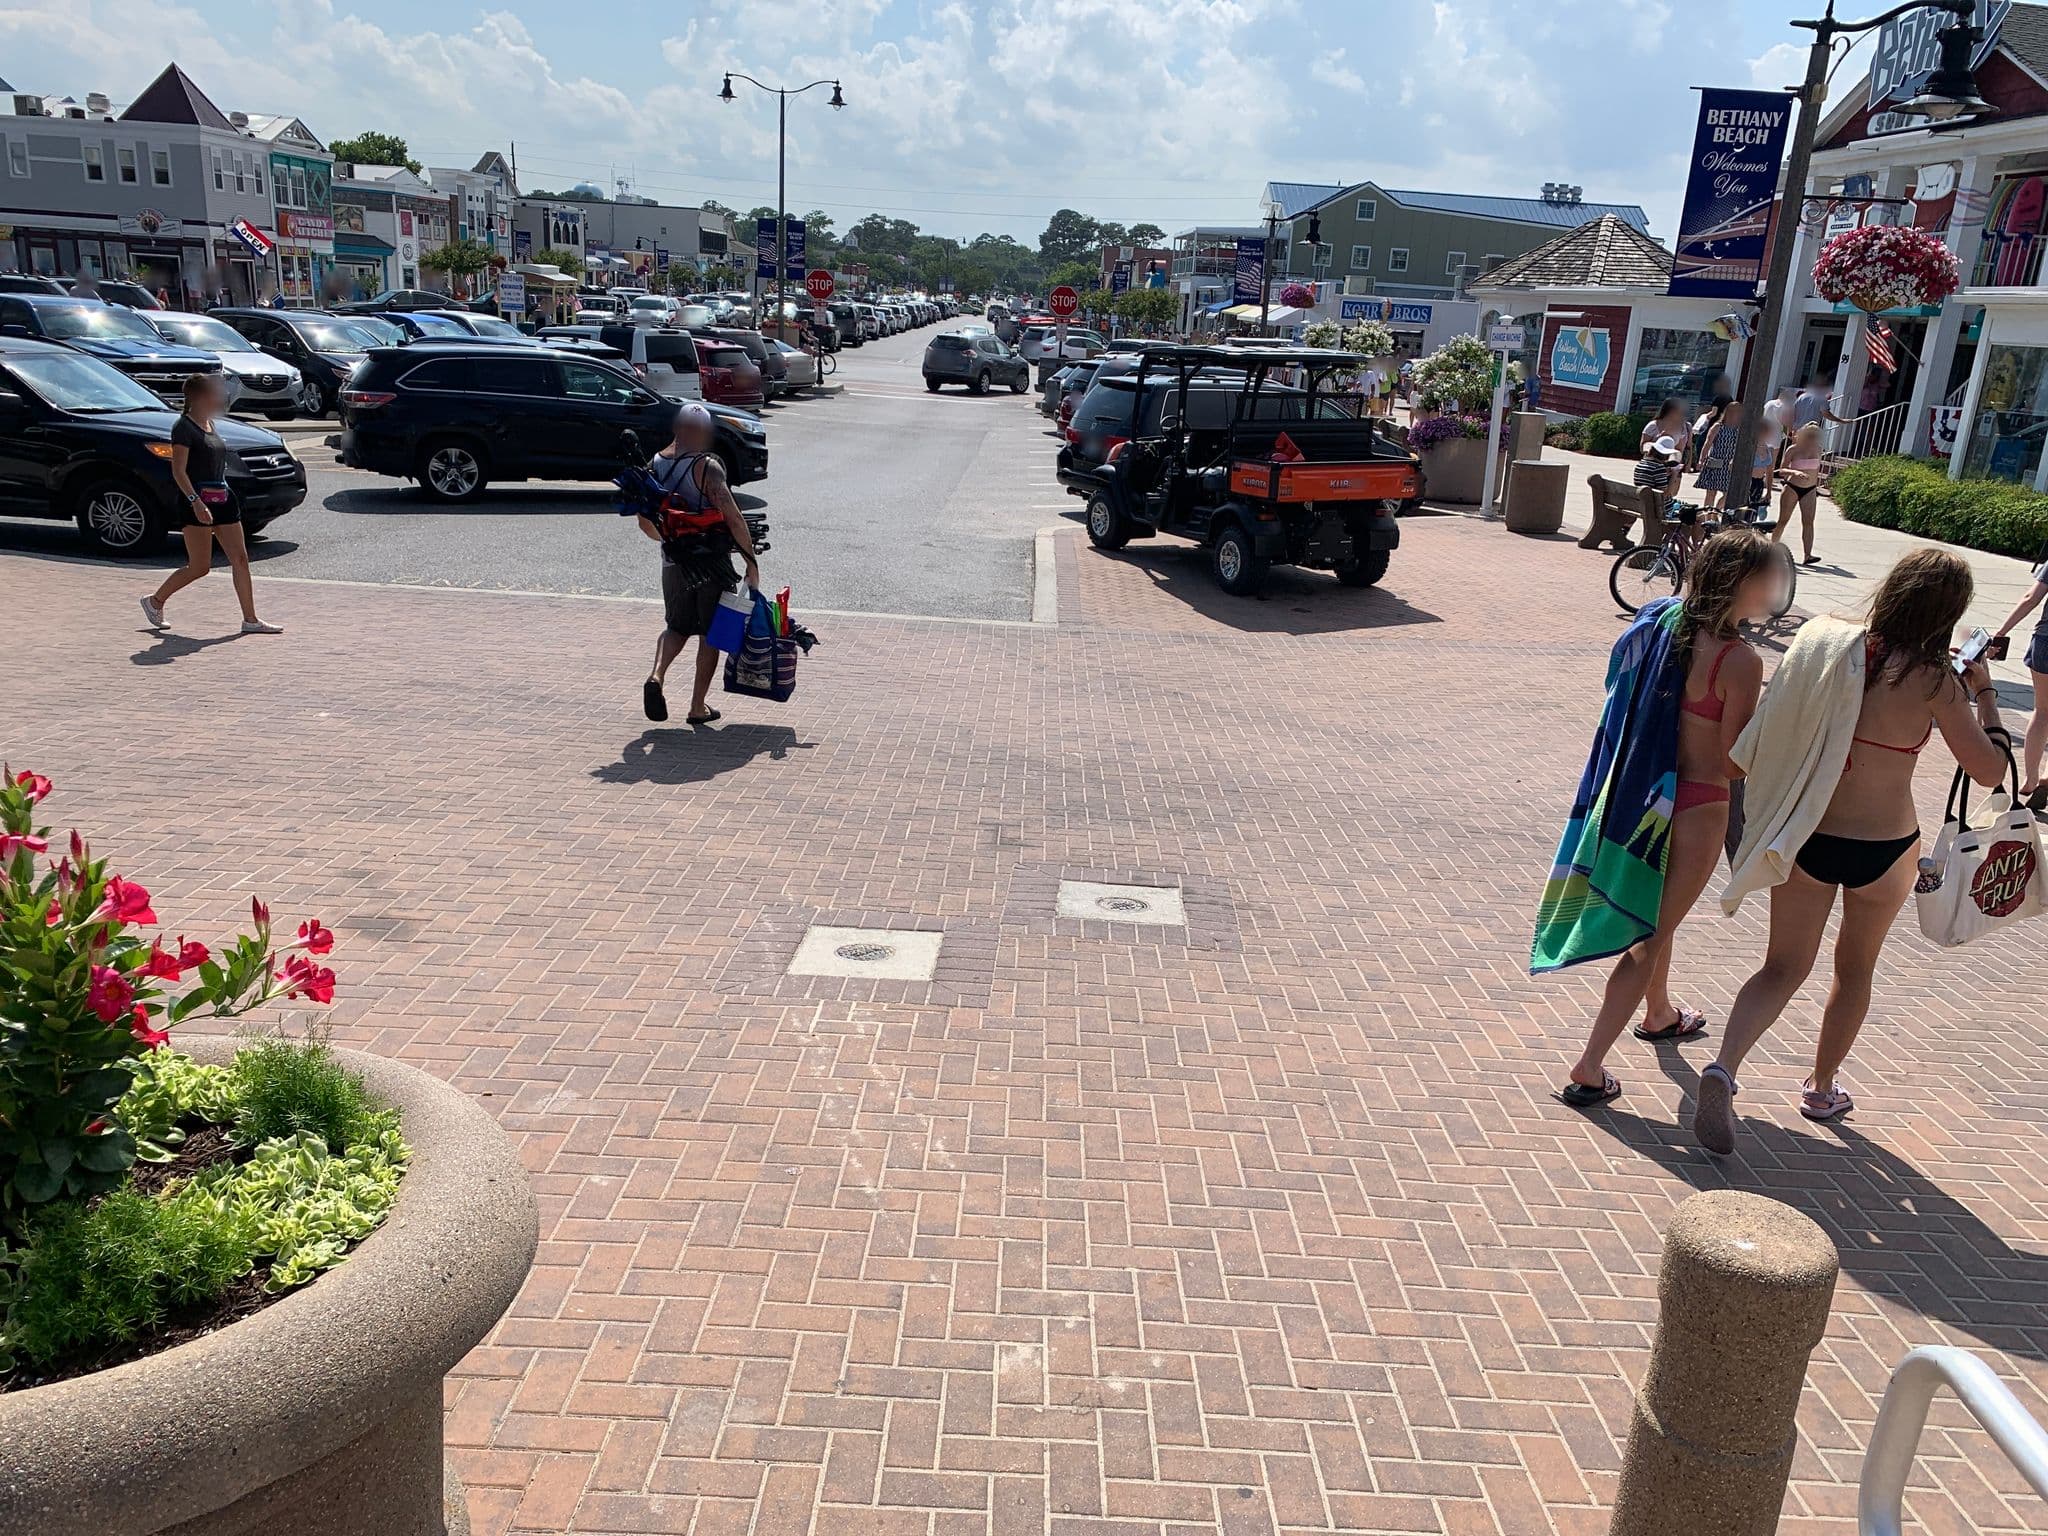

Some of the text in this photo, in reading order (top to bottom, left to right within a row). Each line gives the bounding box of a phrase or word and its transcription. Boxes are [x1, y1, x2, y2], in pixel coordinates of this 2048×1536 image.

[1706, 108, 1784, 128] BETHANY
[1712, 127, 1770, 145] BEACH
[1701, 151, 1769, 173] Welcomes
[1713, 172, 1749, 199] You
[240, 227, 265, 251] OPEN
[807, 278, 833, 291] STOP
[1051, 294, 1076, 307] STOP
[1343, 303, 1379, 319] KOHR
[1557, 338, 1578, 358] Bethany
[1558, 355, 1599, 376] Beach Books
[1840, 353, 1850, 364] 99
[1242, 477, 1267, 489] KUBOTA
[1981, 869, 2026, 914] CRUZ
